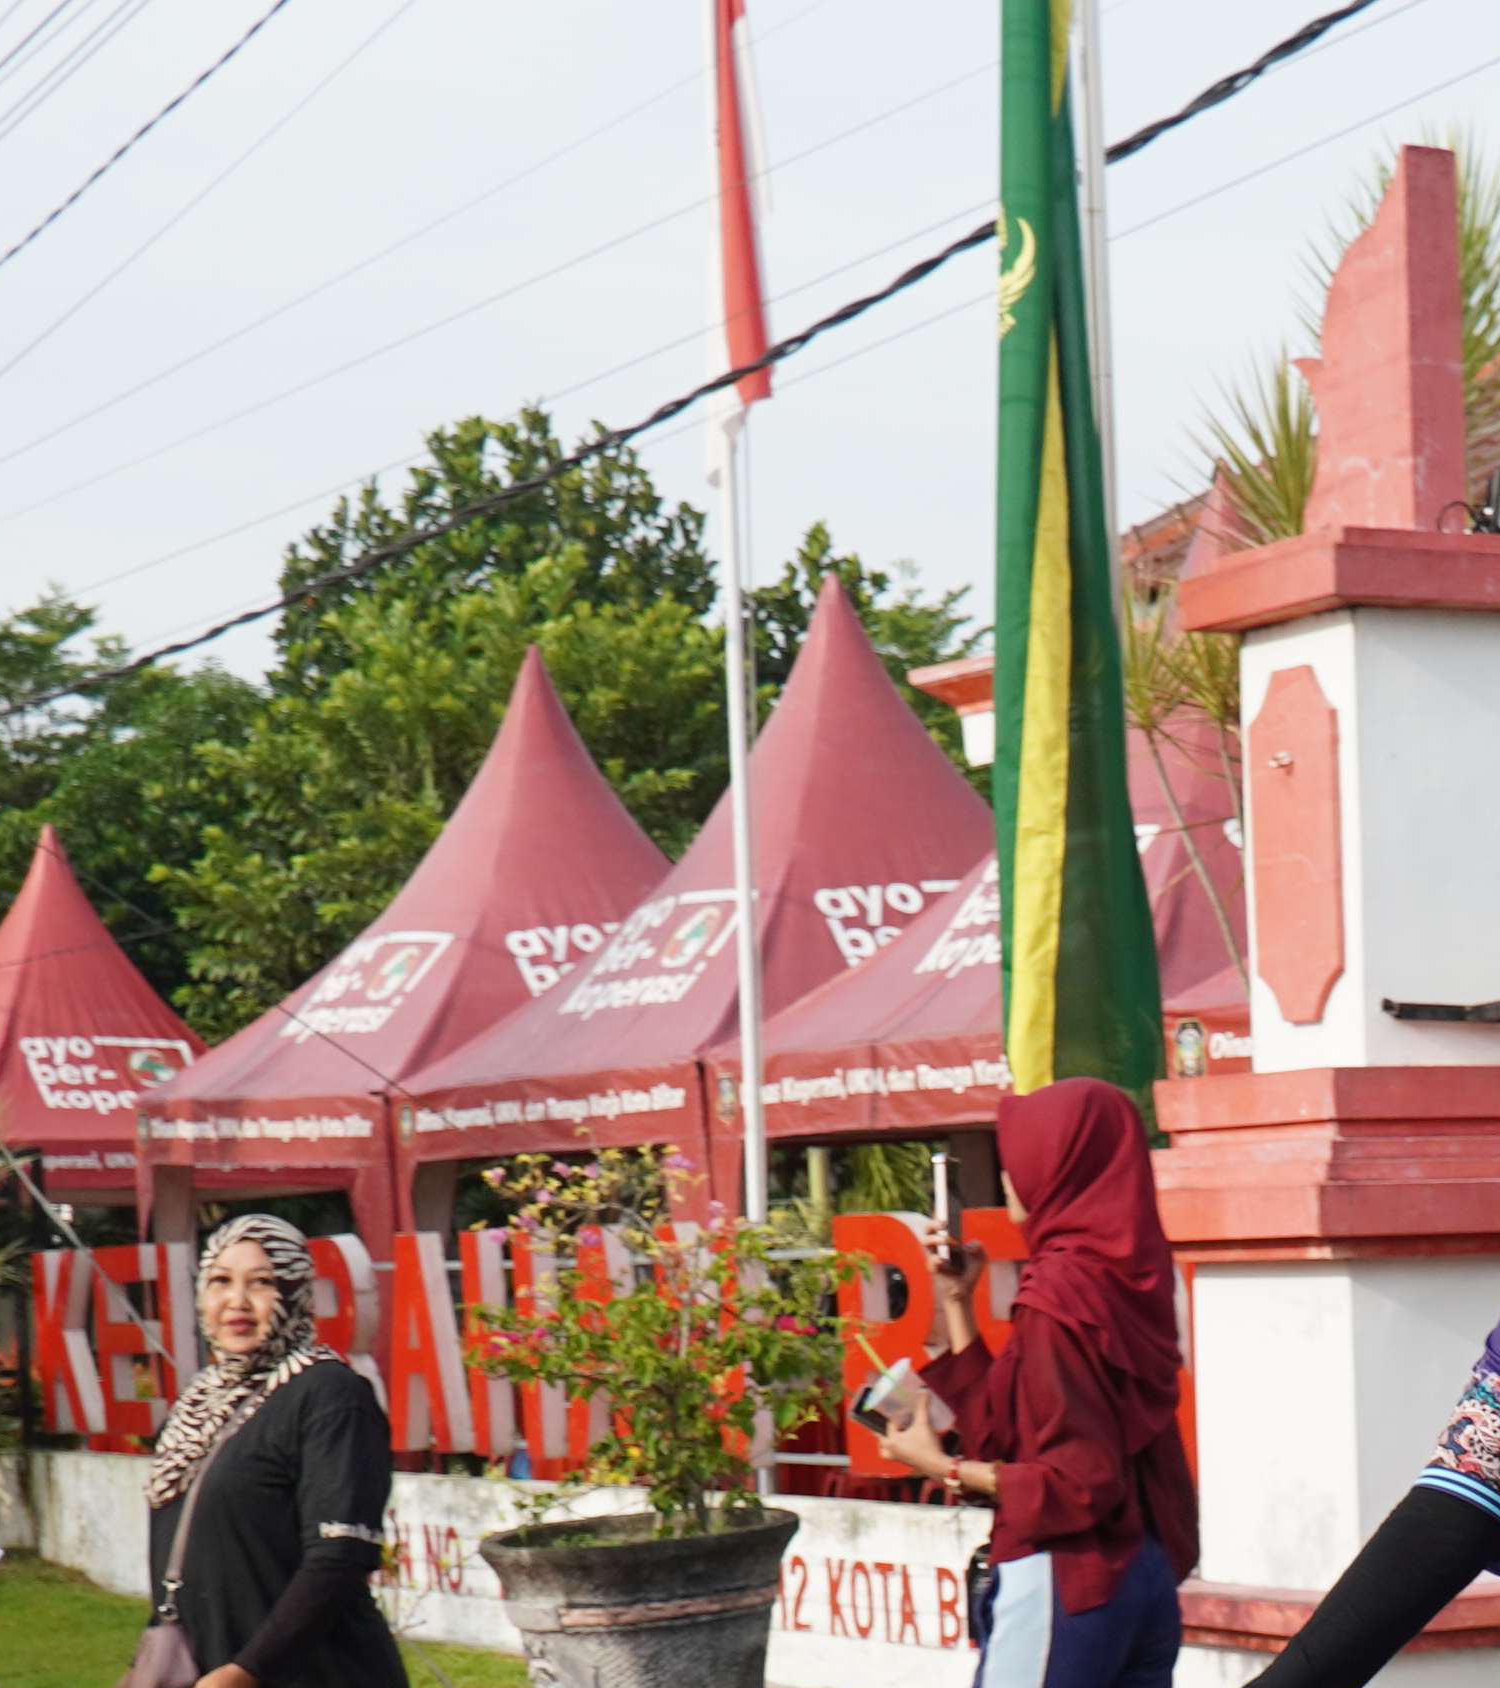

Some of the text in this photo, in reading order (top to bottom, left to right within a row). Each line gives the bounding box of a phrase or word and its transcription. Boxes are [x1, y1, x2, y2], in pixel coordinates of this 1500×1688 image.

[814, 882, 924, 926] ayo
[505, 923, 604, 963] ayo
[19, 1035, 95, 1066] ayo
[25, 1058, 118, 1086] ber-
[826, 1557, 921, 1646] KOTA
